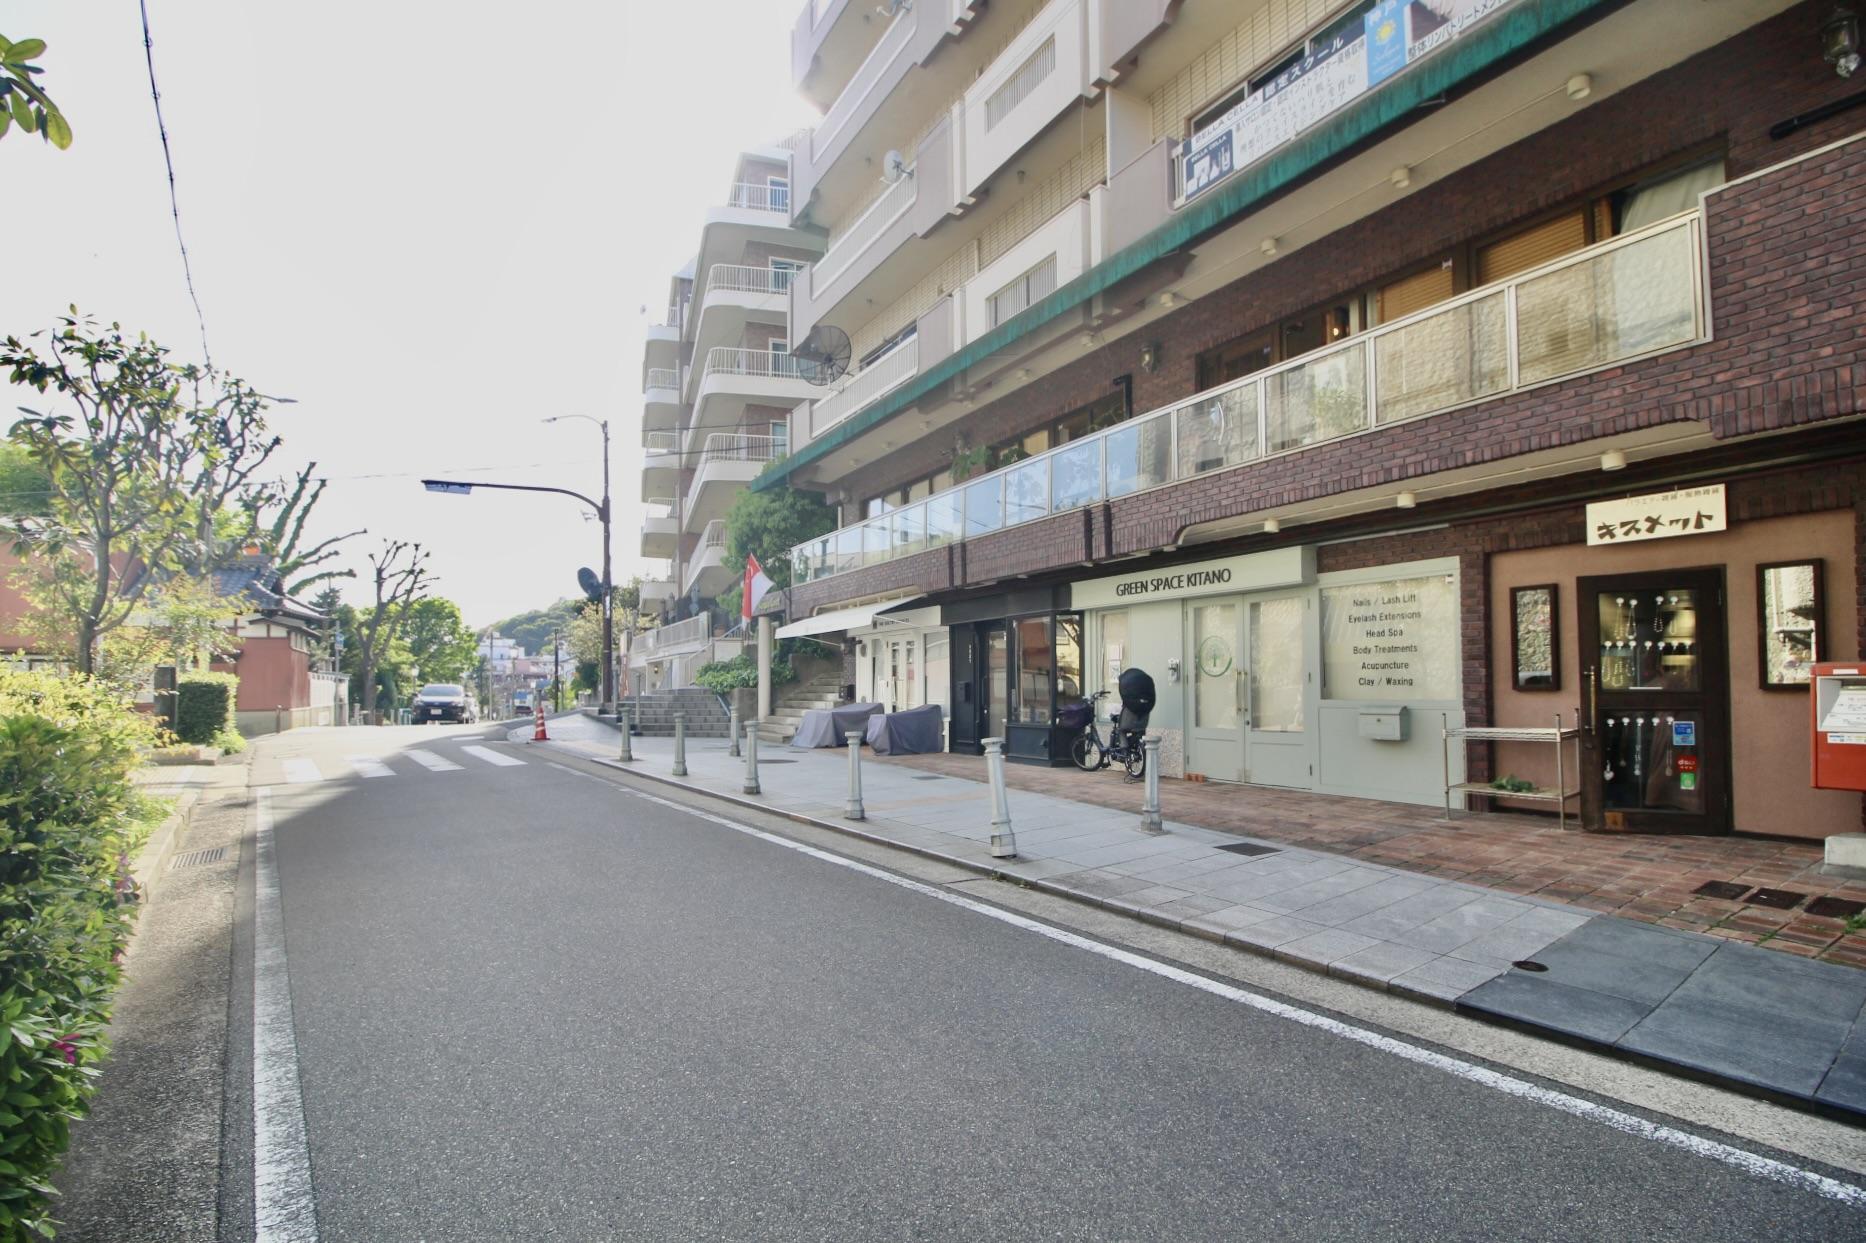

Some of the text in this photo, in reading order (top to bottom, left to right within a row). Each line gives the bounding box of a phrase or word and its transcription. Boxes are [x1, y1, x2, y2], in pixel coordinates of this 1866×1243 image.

[1597, 510, 1713, 540] キスメット
[1116, 568, 1231, 596] GREEN SPACE KITANO
[1353, 598, 1371, 607] Nails
[1382, 596, 1401, 605] Lash
[1403, 593, 1416, 603] Lift
[1348, 611, 1422, 624] Eyelash Extensions
[1366, 628, 1404, 639] Head Spa
[1353, 645, 1418, 655] Body Treatments
[1361, 662, 1409, 670] Acupuncture
[1358, 677, 1375, 686] Clay
[1386, 677, 1414, 687] Waxing
